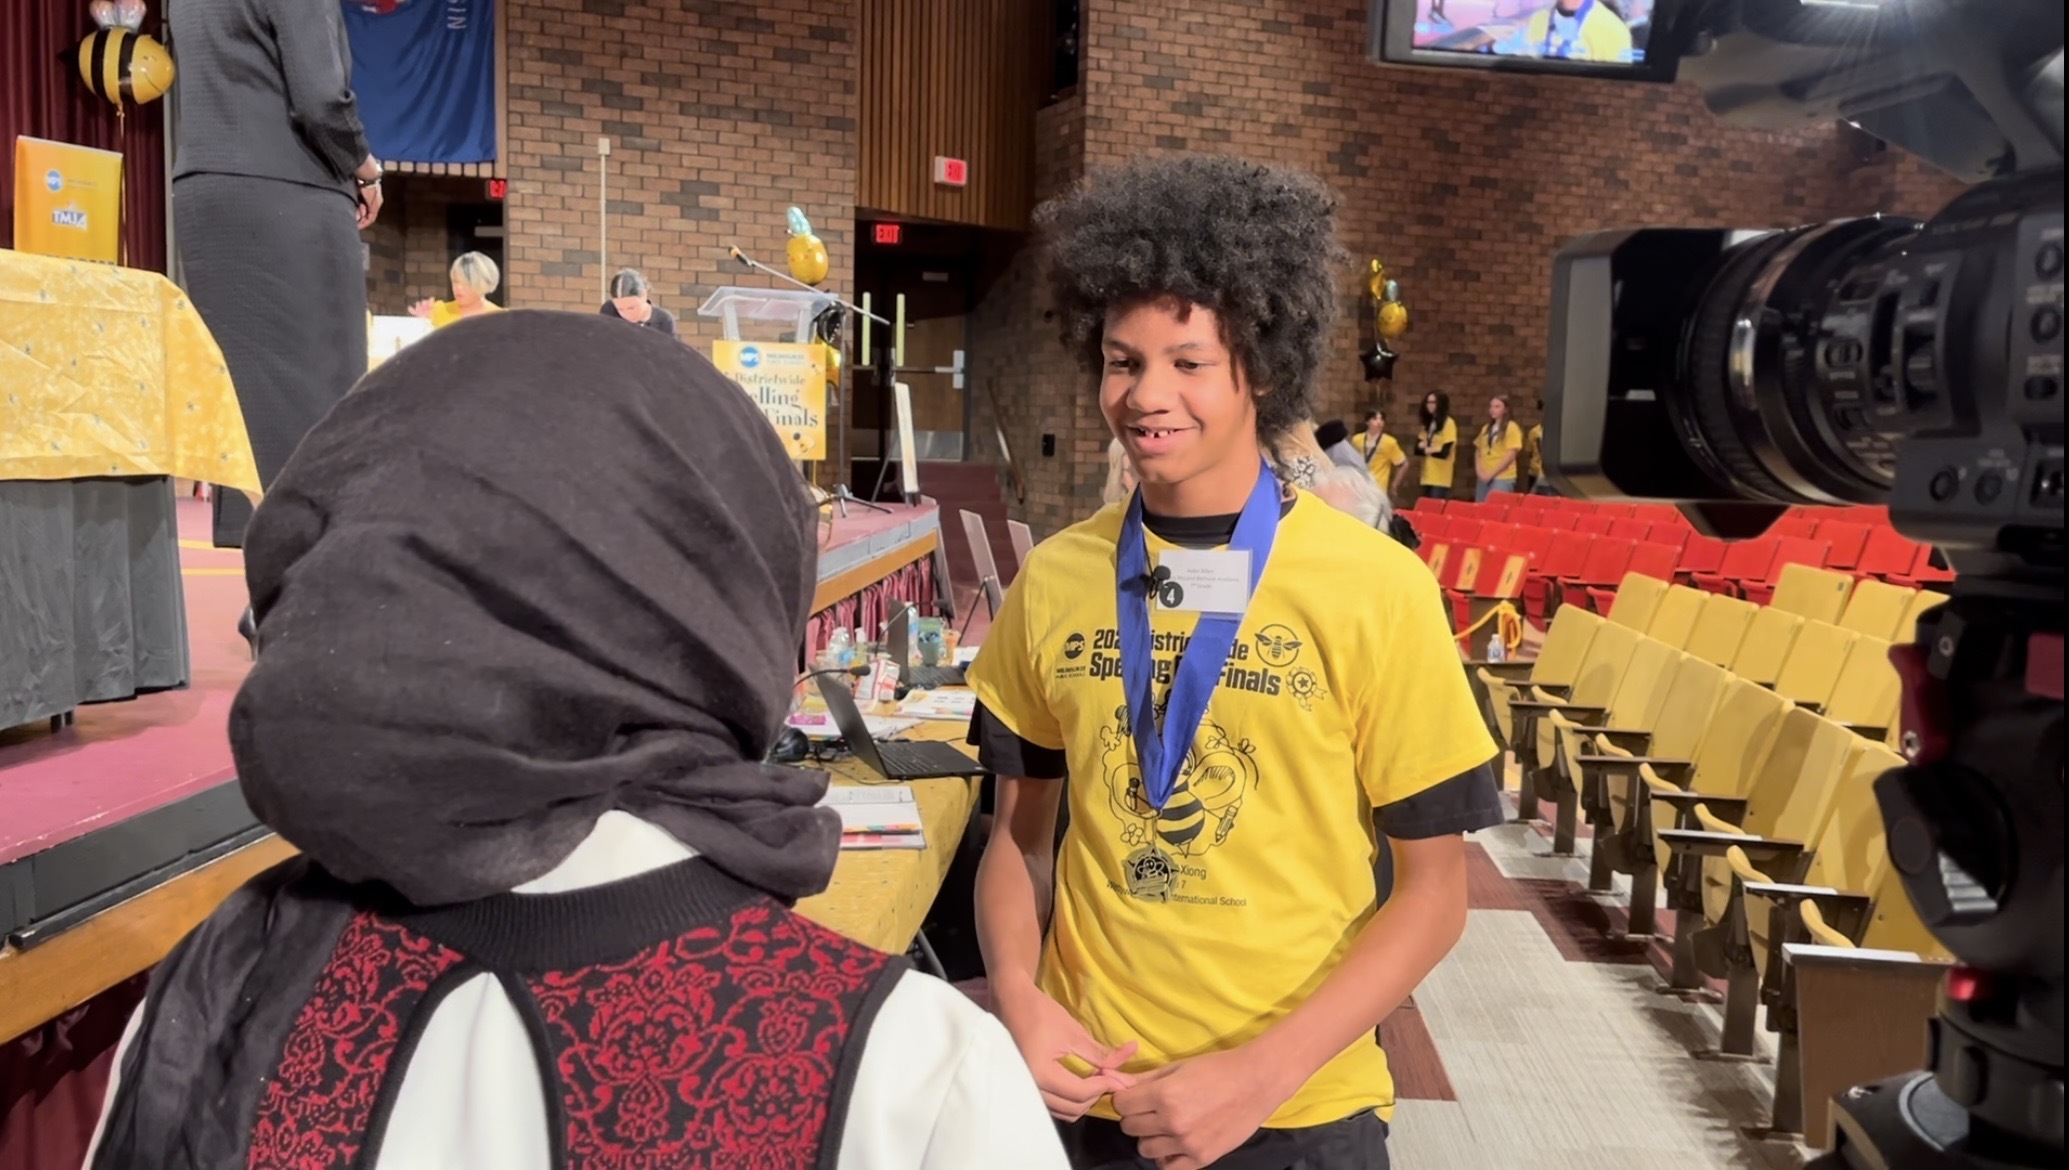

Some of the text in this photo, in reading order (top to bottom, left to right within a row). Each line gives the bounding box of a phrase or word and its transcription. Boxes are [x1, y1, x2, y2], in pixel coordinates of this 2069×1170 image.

[447, 0, 467, 29] IN
[876, 224, 899, 243] EXIT
[1166, 588, 1175, 604] 4
[1093, 629, 1120, 649] 202
[1180, 864, 1207, 880] Xiong
[1220, 898, 1246, 907] School
